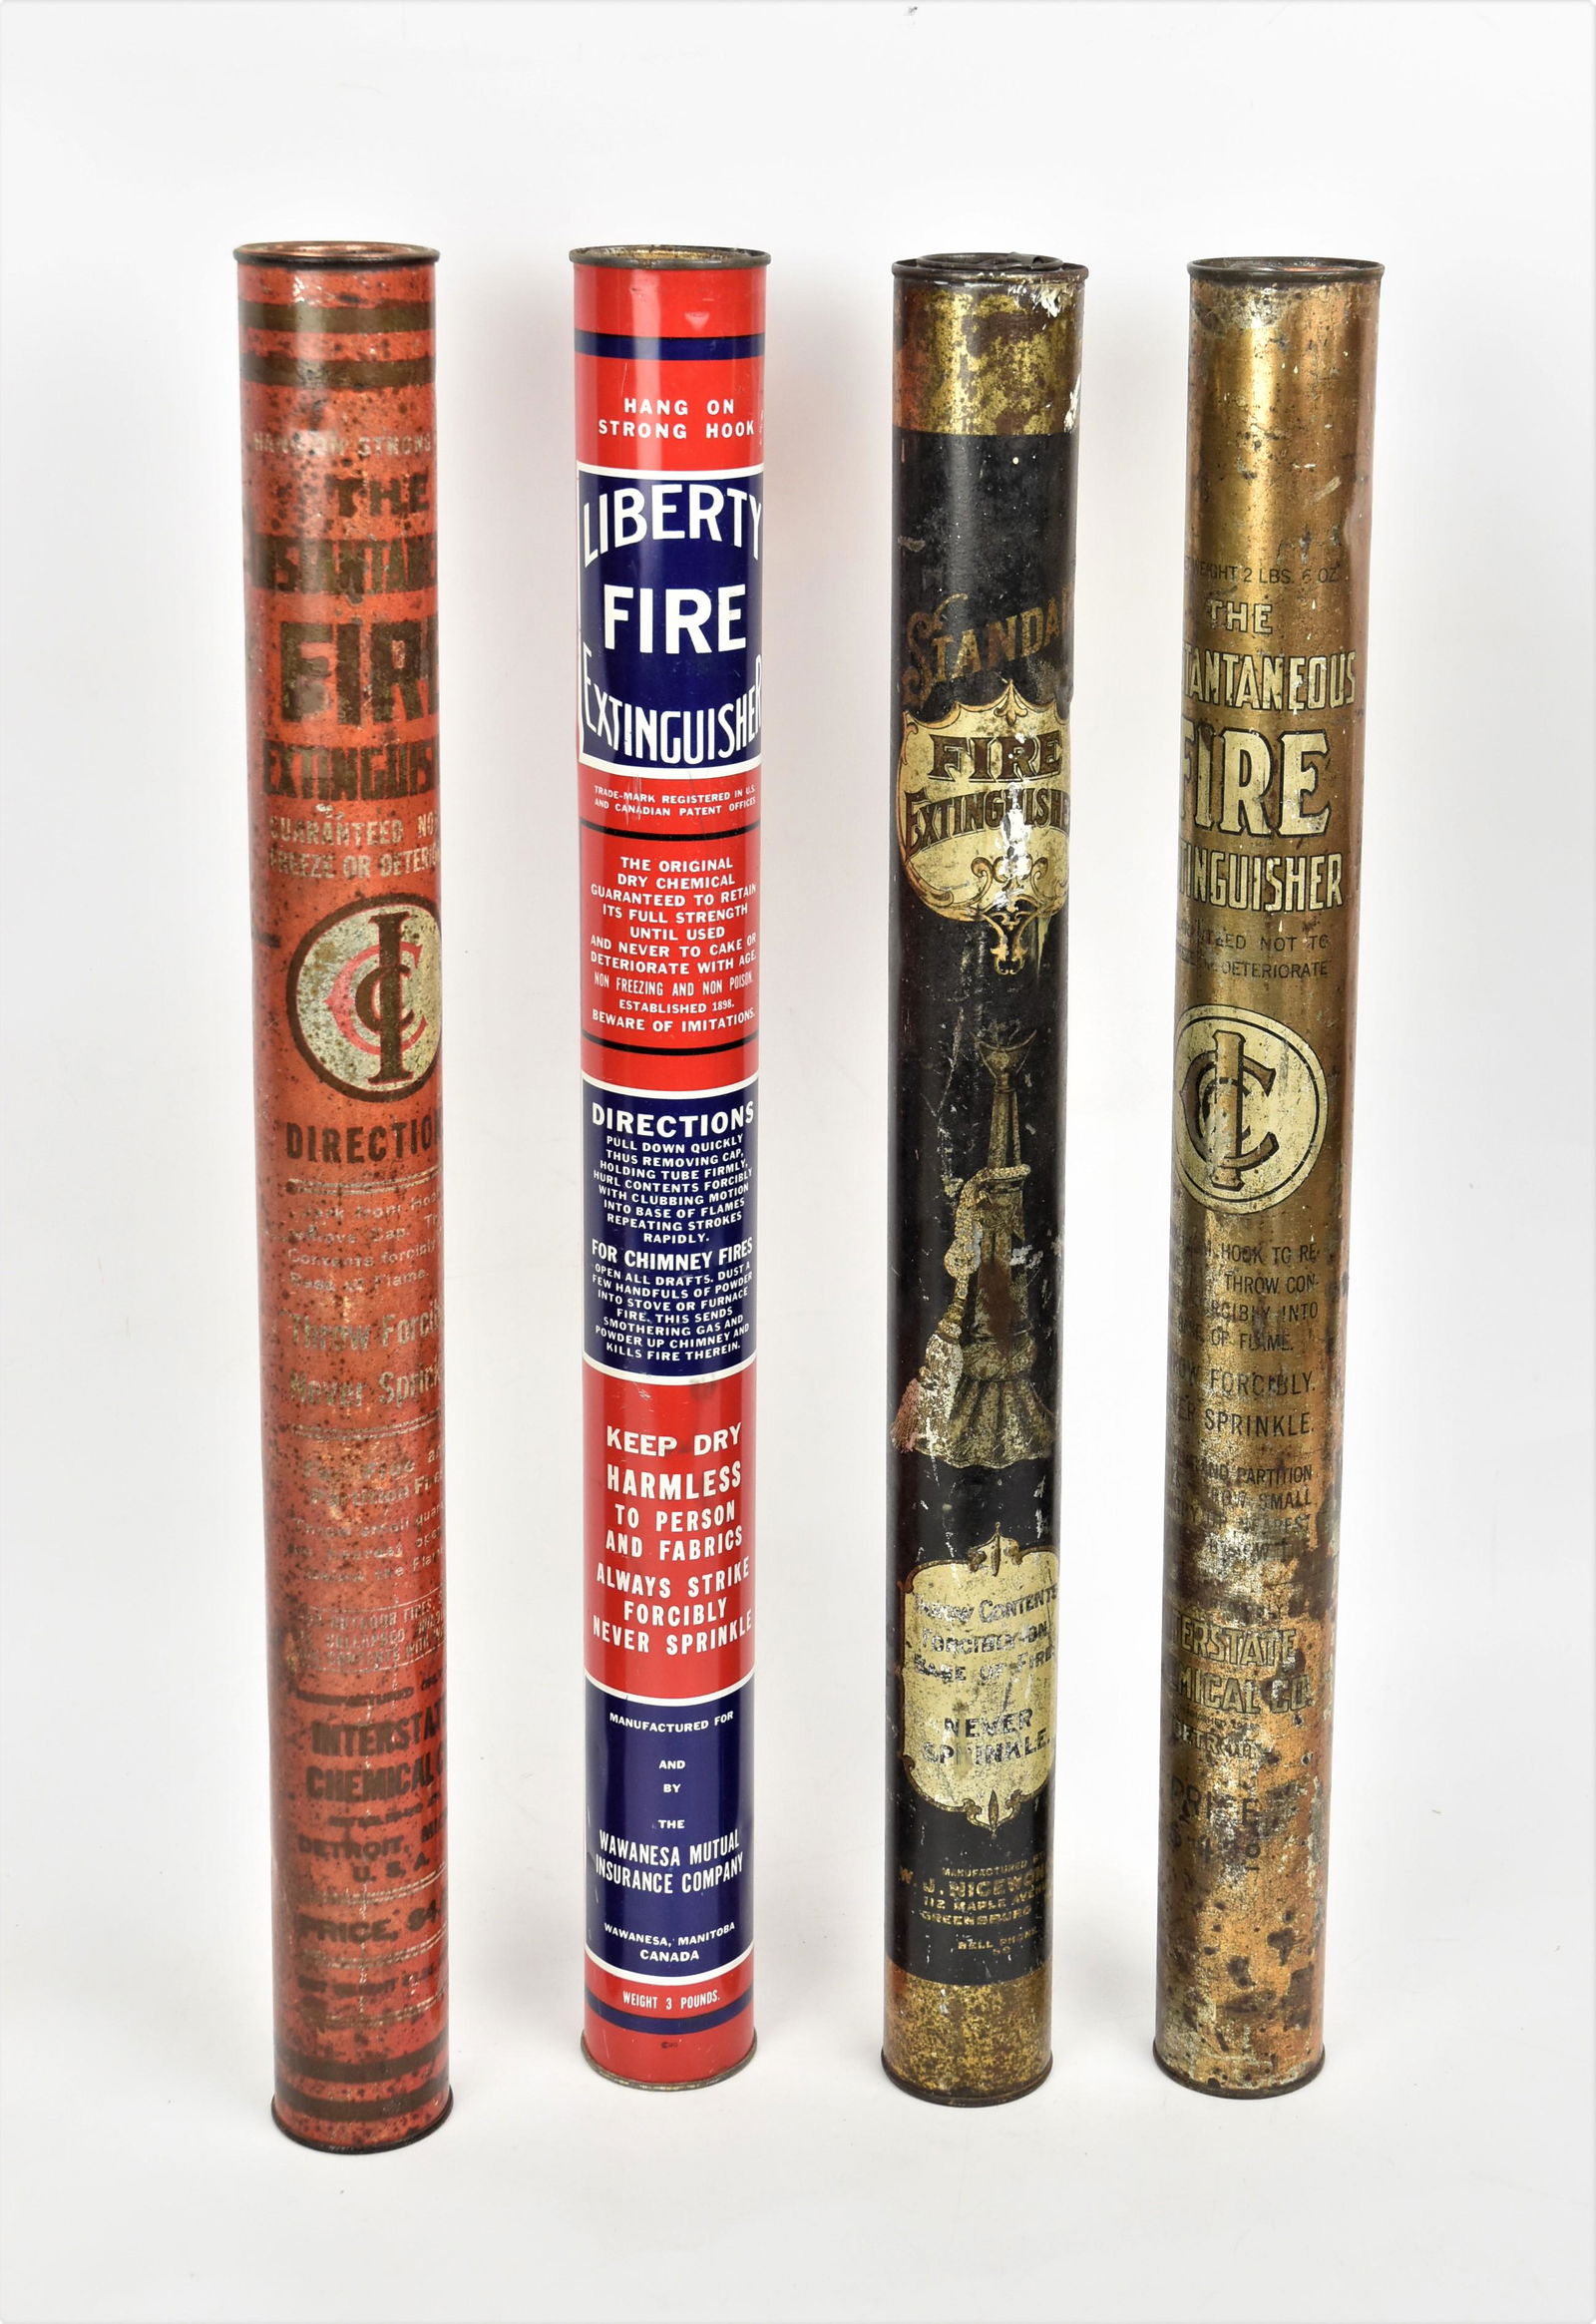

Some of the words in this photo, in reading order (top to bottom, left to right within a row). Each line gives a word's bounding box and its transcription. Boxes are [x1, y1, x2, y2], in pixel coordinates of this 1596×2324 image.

[624, 398, 688, 415] HANG
[707, 400, 734, 414] ON
[598, 419, 687, 439] STRONG
[706, 421, 754, 438] HOOK
[584, 484, 762, 569] LIBERTY
[1244, 568, 1252, 582] 2
[604, 584, 746, 654] FIRE
[1207, 598, 1273, 634] THE
[583, 642, 762, 764] EXTINGUISHER
[928, 730, 1062, 783] FIRE
[595, 786, 655, 803] TRADE-MARK
[662, 792, 730, 804] REGISTERED
[735, 789, 743, 798] IN
[595, 798, 609, 809] AND
[615, 804, 670, 816] CANADIAN
[679, 806, 721, 816] PATENT
[729, 798, 756, 811] OFFICES
[343, 855, 371, 879] OR
[620, 857, 651, 871] THE
[659, 857, 733, 872] ORIGINAL
[617, 874, 647, 888] DRY
[656, 875, 735, 890] CHEMICAL
[592, 884, 685, 907] GUARANTEED
[694, 894, 713, 906] TO
[721, 883, 756, 904] RETAIN
[602, 904, 622, 918] ITS
[629, 910, 667, 923] FULL
[676, 904, 747, 924] STRENGTH
[591, 935, 611, 950] AND
[618, 942, 669, 958] NEVER
[679, 947, 701, 958] TO
[709, 939, 742, 956] CAKE
[747, 933, 756, 945] OR
[630, 927, 678, 941] UNTIL
[687, 927, 725, 941] USED
[1261, 936, 1297, 952] NOT
[591, 952, 689, 974] DETERIORATE
[697, 959, 733, 973] WITH
[739, 950, 756, 966] AGE.
[595, 971, 609, 987] NON
[616, 977, 663, 995] FREEZING
[672, 982, 694, 996] AND
[703, 979, 722, 995] NON
[619, 999, 706, 1013] ESTABLISHED
[712, 999, 734, 1011] 1898.
[593, 1009, 644, 1030] BEWARE
[652, 1021, 673, 1032] OF
[682, 1008, 755, 1032] IMITATIONS.
[593, 1100, 754, 1137] DIRECTIONS
[606, 1136, 637, 1150] PULL
[642, 1143, 684, 1153] DOWN
[691, 1134, 743, 1153] QUICKLY
[600, 1160, 655, 1179] HOLDING
[661, 1170, 699, 1180] TUBE
[705, 1159, 748, 1178] FIRMLY,
[606, 1149, 637, 1164] THUS
[643, 1155, 718, 1167] REMOVING
[723, 1149, 743, 1161] CAP,
[594, 1171, 620, 1186] HURL
[625, 1180, 698, 1193] CONTENTS
[704, 1168, 752, 1191] FORCIBLY
[598, 1185, 626, 1200] WITH
[631, 1194, 703, 1206] CLUBBING
[709, 1184, 748, 1203] MOTION
[604, 1200, 630, 1213] INTO
[636, 1207, 671, 1218] BASE
[676, 1209, 695, 1218] OF
[701, 1197, 745, 1217] FLAMES
[607, 1214, 682, 1231] REPEATING
[688, 1212, 742, 1230] STROKES
[644, 1233, 709, 1244] RAPIDLY.
[593, 1239, 616, 1263] FOR
[624, 1250, 712, 1271] CHIMNEY
[718, 1237, 752, 1265] FIRES
[593, 1275, 611, 1289] FEW
[616, 1283, 688, 1299] HANDFULS
[694, 1287, 710, 1297] OF
[715, 1272, 752, 1294] POWDER
[596, 1264, 620, 1279] OPEN
[625, 1274, 650, 1285] ALL
[655, 1275, 713, 1286] DRAFTS.
[718, 1265, 742, 1281] DUST
[746, 1261, 750, 1270] A
[1225, 1273, 1280, 1294] THROW
[598, 1290, 622, 1305] INTO
[627, 1299, 670, 1312] STOVE
[676, 1302, 695, 1311] OR
[701, 1287, 748, 1309] FURNACE
[603, 1317, 690, 1336] SMOTHERING
[696, 1323, 720, 1335] GAS
[725, 1315, 743, 1329] AND
[617, 1309, 650, 1322] FIRE.
[655, 1314, 689, 1323] THIS
[695, 1307, 733, 1323] SENDS
[596, 1326, 642, 1346] POWDER
[647, 1338, 664, 1348] UP
[669, 1331, 729, 1349] CHIMNEY
[733, 1324, 749, 1338] AND
[606, 1343, 641, 1357] KILLS
[647, 1352, 680, 1360] FIRE
[685, 1342, 740, 1360] THEREIN.
[1205, 1408, 1314, 1437] SPRINKLE.
[606, 1425, 677, 1457] KEEP
[694, 1422, 741, 1456] DRY
[606, 1460, 741, 1500] HARMLESS
[615, 1503, 639, 1528] TO
[656, 1499, 735, 1532] PERSON
[605, 1530, 642, 1558] AND
[660, 1525, 742, 1562] FABRICS
[597, 1562, 671, 1598] ALWAYS
[688, 1556, 749, 1598] STRIKE
[624, 1597, 727, 1627] FORCIBLY
[594, 1615, 649, 1653] NEVER
[666, 1609, 751, 1656] SPRINKLE
[609, 1713, 709, 1733] MANUFACTURED
[714, 1711, 733, 1726] FOR
[945, 1709, 1033, 1738] NEVER
[659, 1760, 685, 1769] AND
[658, 1820, 684, 1829] THE
[599, 1829, 680, 1867] WAWANESA
[690, 1829, 739, 1865] MUTUAL
[596, 1853, 672, 1893] INSURANCE
[682, 1851, 742, 1893] COMPANY
[604, 1923, 671, 1947] WAWANESA,
[678, 1922, 735, 1945] MANITOBA
[640, 1950, 699, 1962] CANADA
[623, 1991, 657, 2009] WEIGHT
[666, 1998, 671, 2010] 3
[681, 1990, 720, 2009] POUNDS.
